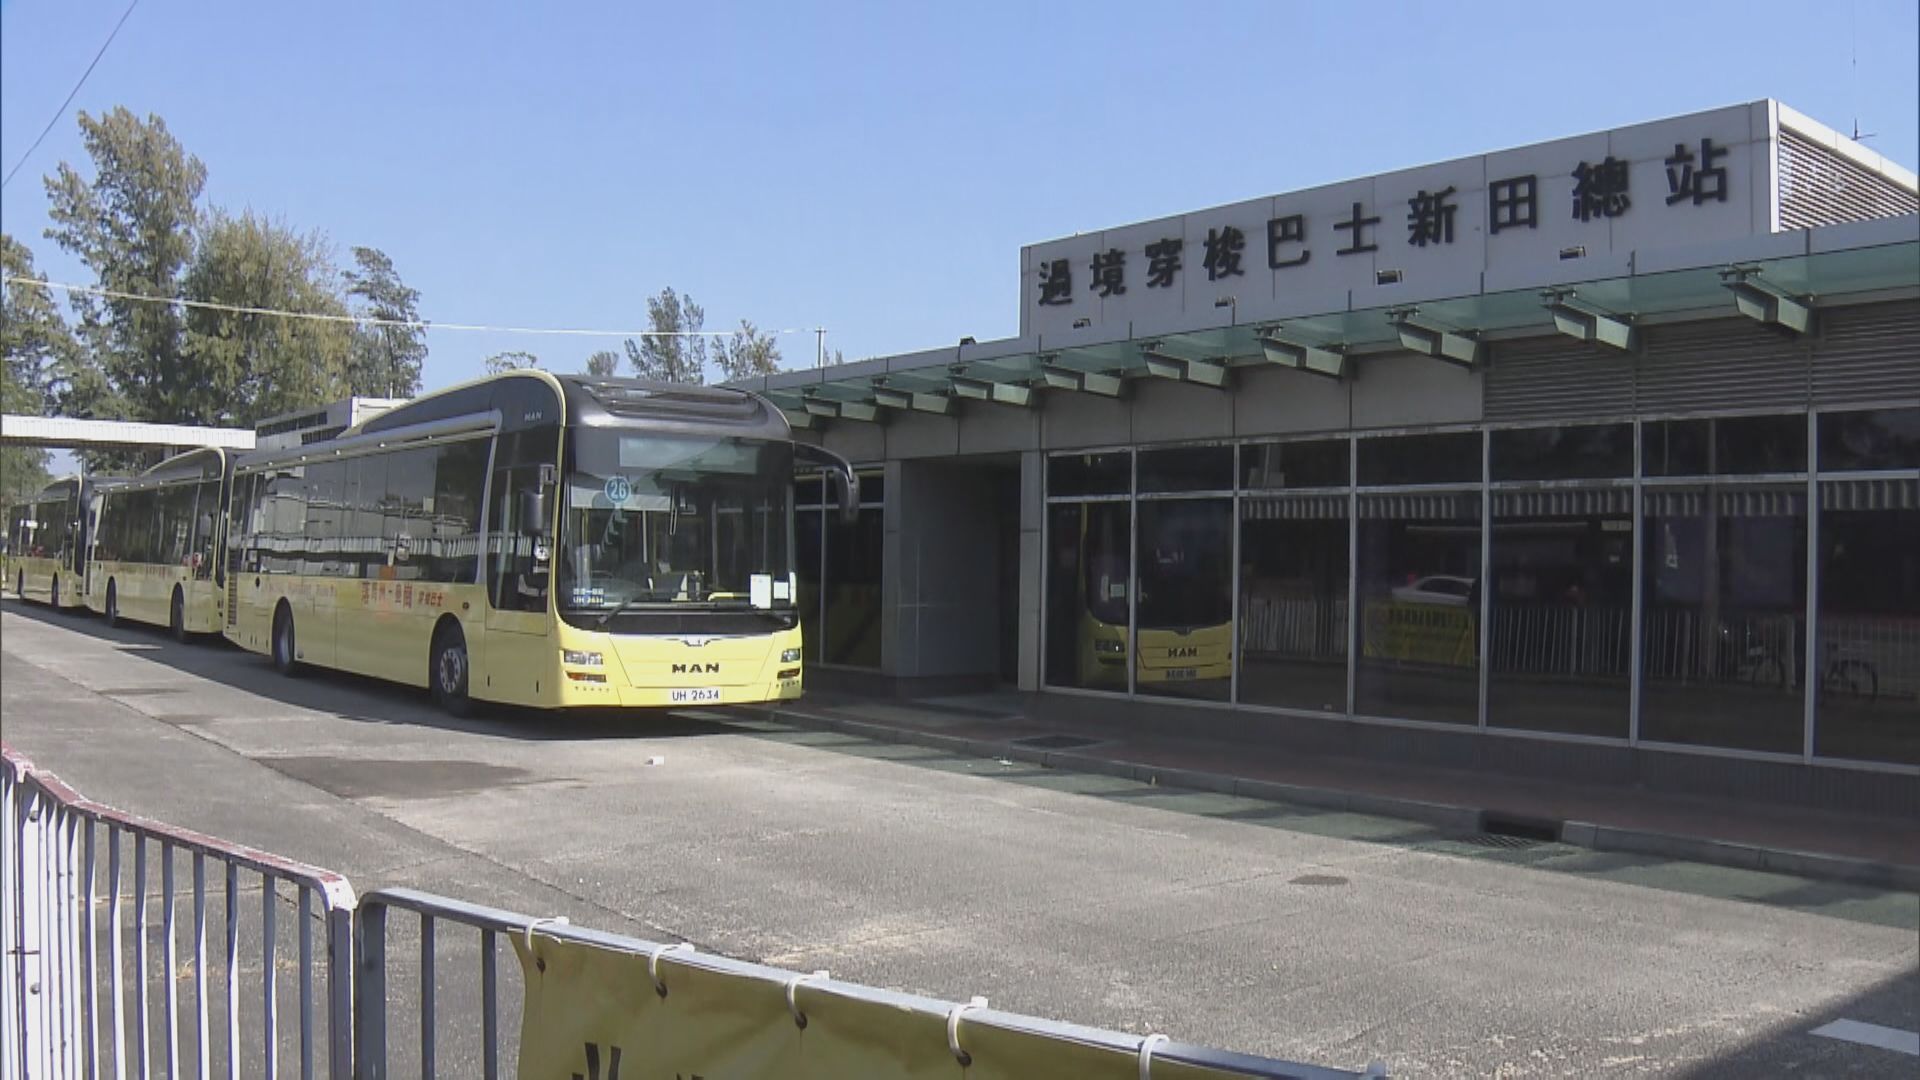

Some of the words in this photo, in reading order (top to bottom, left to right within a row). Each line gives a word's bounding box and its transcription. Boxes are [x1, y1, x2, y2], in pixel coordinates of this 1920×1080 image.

[1037, 138, 1729, 307] 過境穿梭巴士新田總站
[610, 480, 627, 499] 26
[671, 663, 719, 674] MAN
[671, 689, 687, 702] UH
[691, 688, 719, 702] 2634
